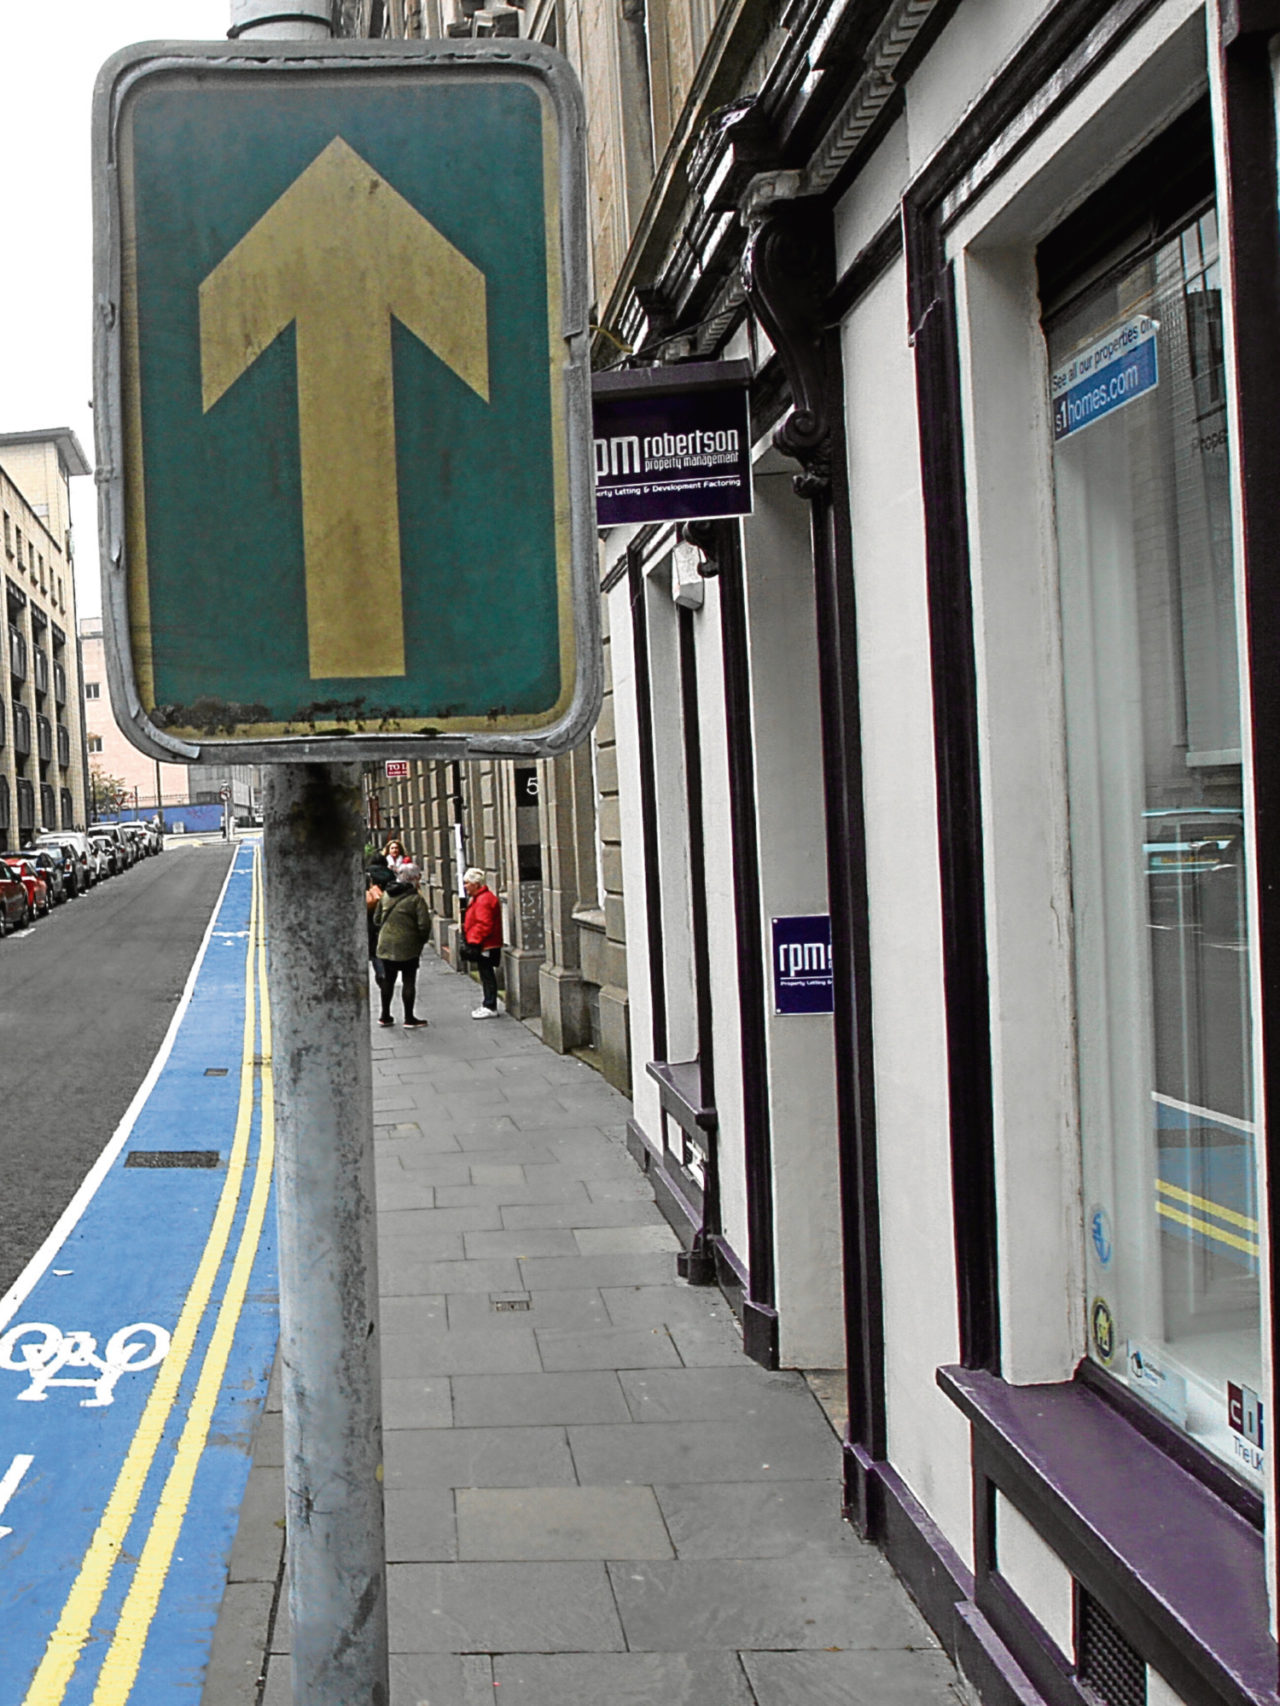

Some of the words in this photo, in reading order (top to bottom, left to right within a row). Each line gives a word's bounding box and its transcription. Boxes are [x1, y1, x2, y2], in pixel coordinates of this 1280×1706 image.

[1052, 374, 1067, 392] See
[1068, 362, 1078, 382] all
[1079, 354, 1093, 375] our
[1094, 325, 1139, 369] properties
[1055, 364, 1139, 432] s1homes.com
[593, 435, 641, 486] pm
[643, 429, 739, 459] robertson
[644, 457, 682, 473] property
[683, 451, 740, 468] management
[596, 489, 613, 498] erty
[614, 486, 641, 496] Letting
[643, 486, 651, 494] &
[652, 482, 702, 494] Development
[703, 478, 741, 489] Factoring
[387, 763, 401, 771] TO
[778, 942, 826, 977] rpm
